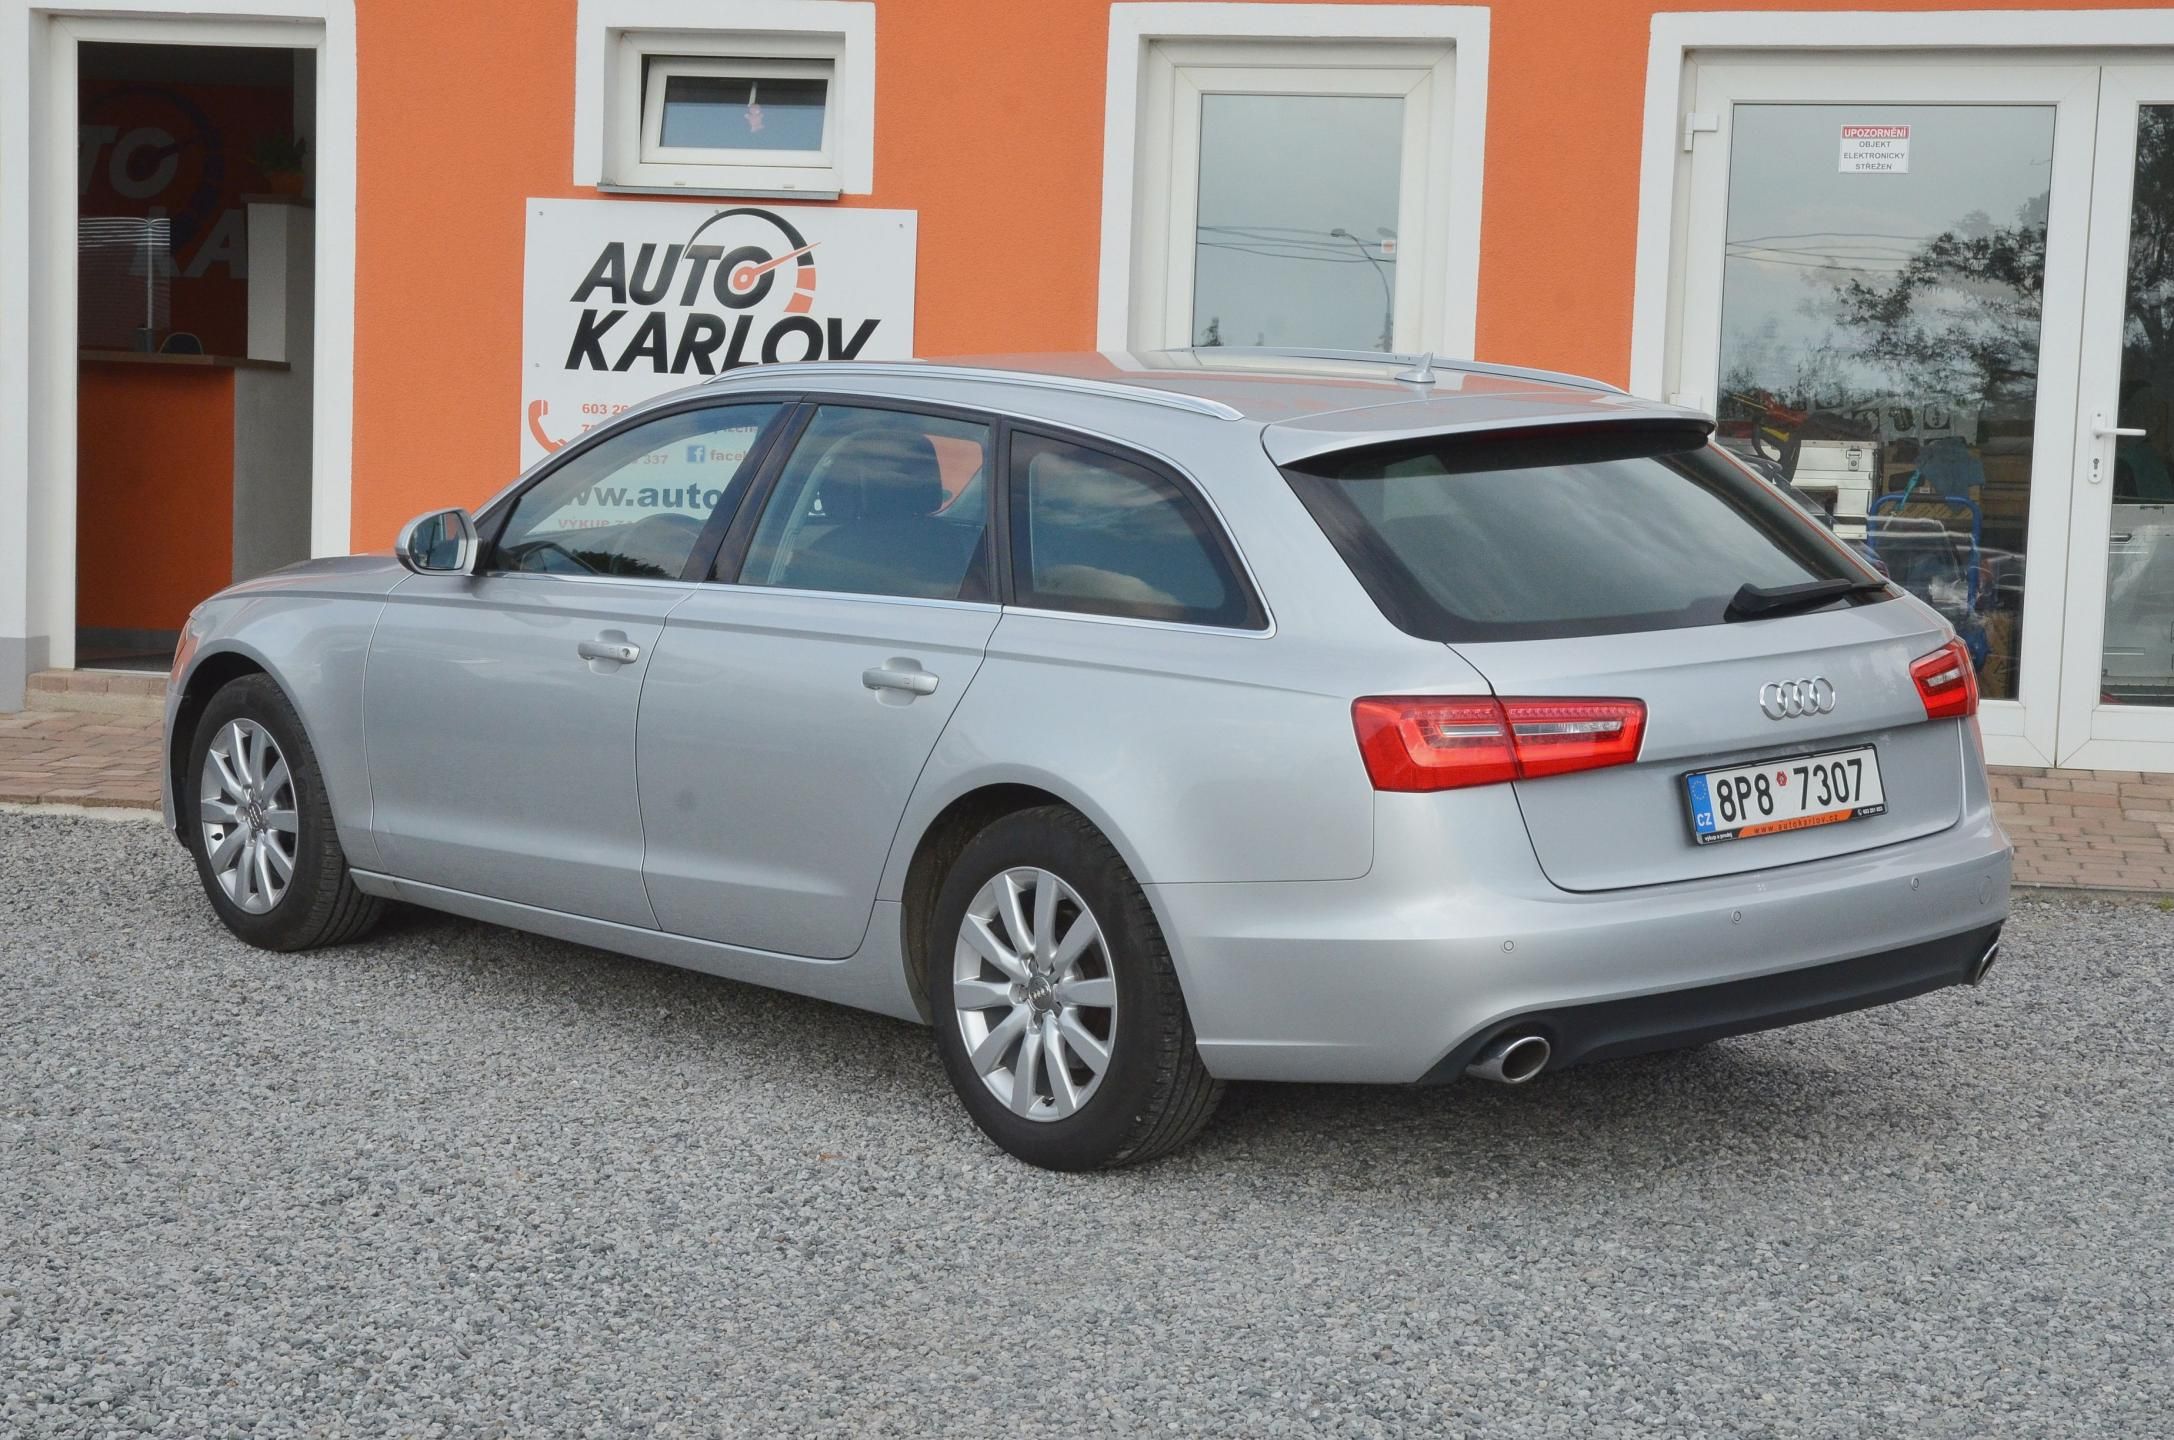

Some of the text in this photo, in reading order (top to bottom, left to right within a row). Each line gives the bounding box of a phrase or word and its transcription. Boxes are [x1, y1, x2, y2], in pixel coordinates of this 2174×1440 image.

[1844, 127, 1906, 138] UPOZORNĚNÍ
[1855, 162, 1892, 170] STŘEŽEN
[570, 241, 775, 309] AUTO
[565, 309, 881, 375] KARLOV
[582, 403, 607, 415] 603
[1716, 758, 1862, 823] 8P8 7307
[1697, 812, 1713, 827] CZ
